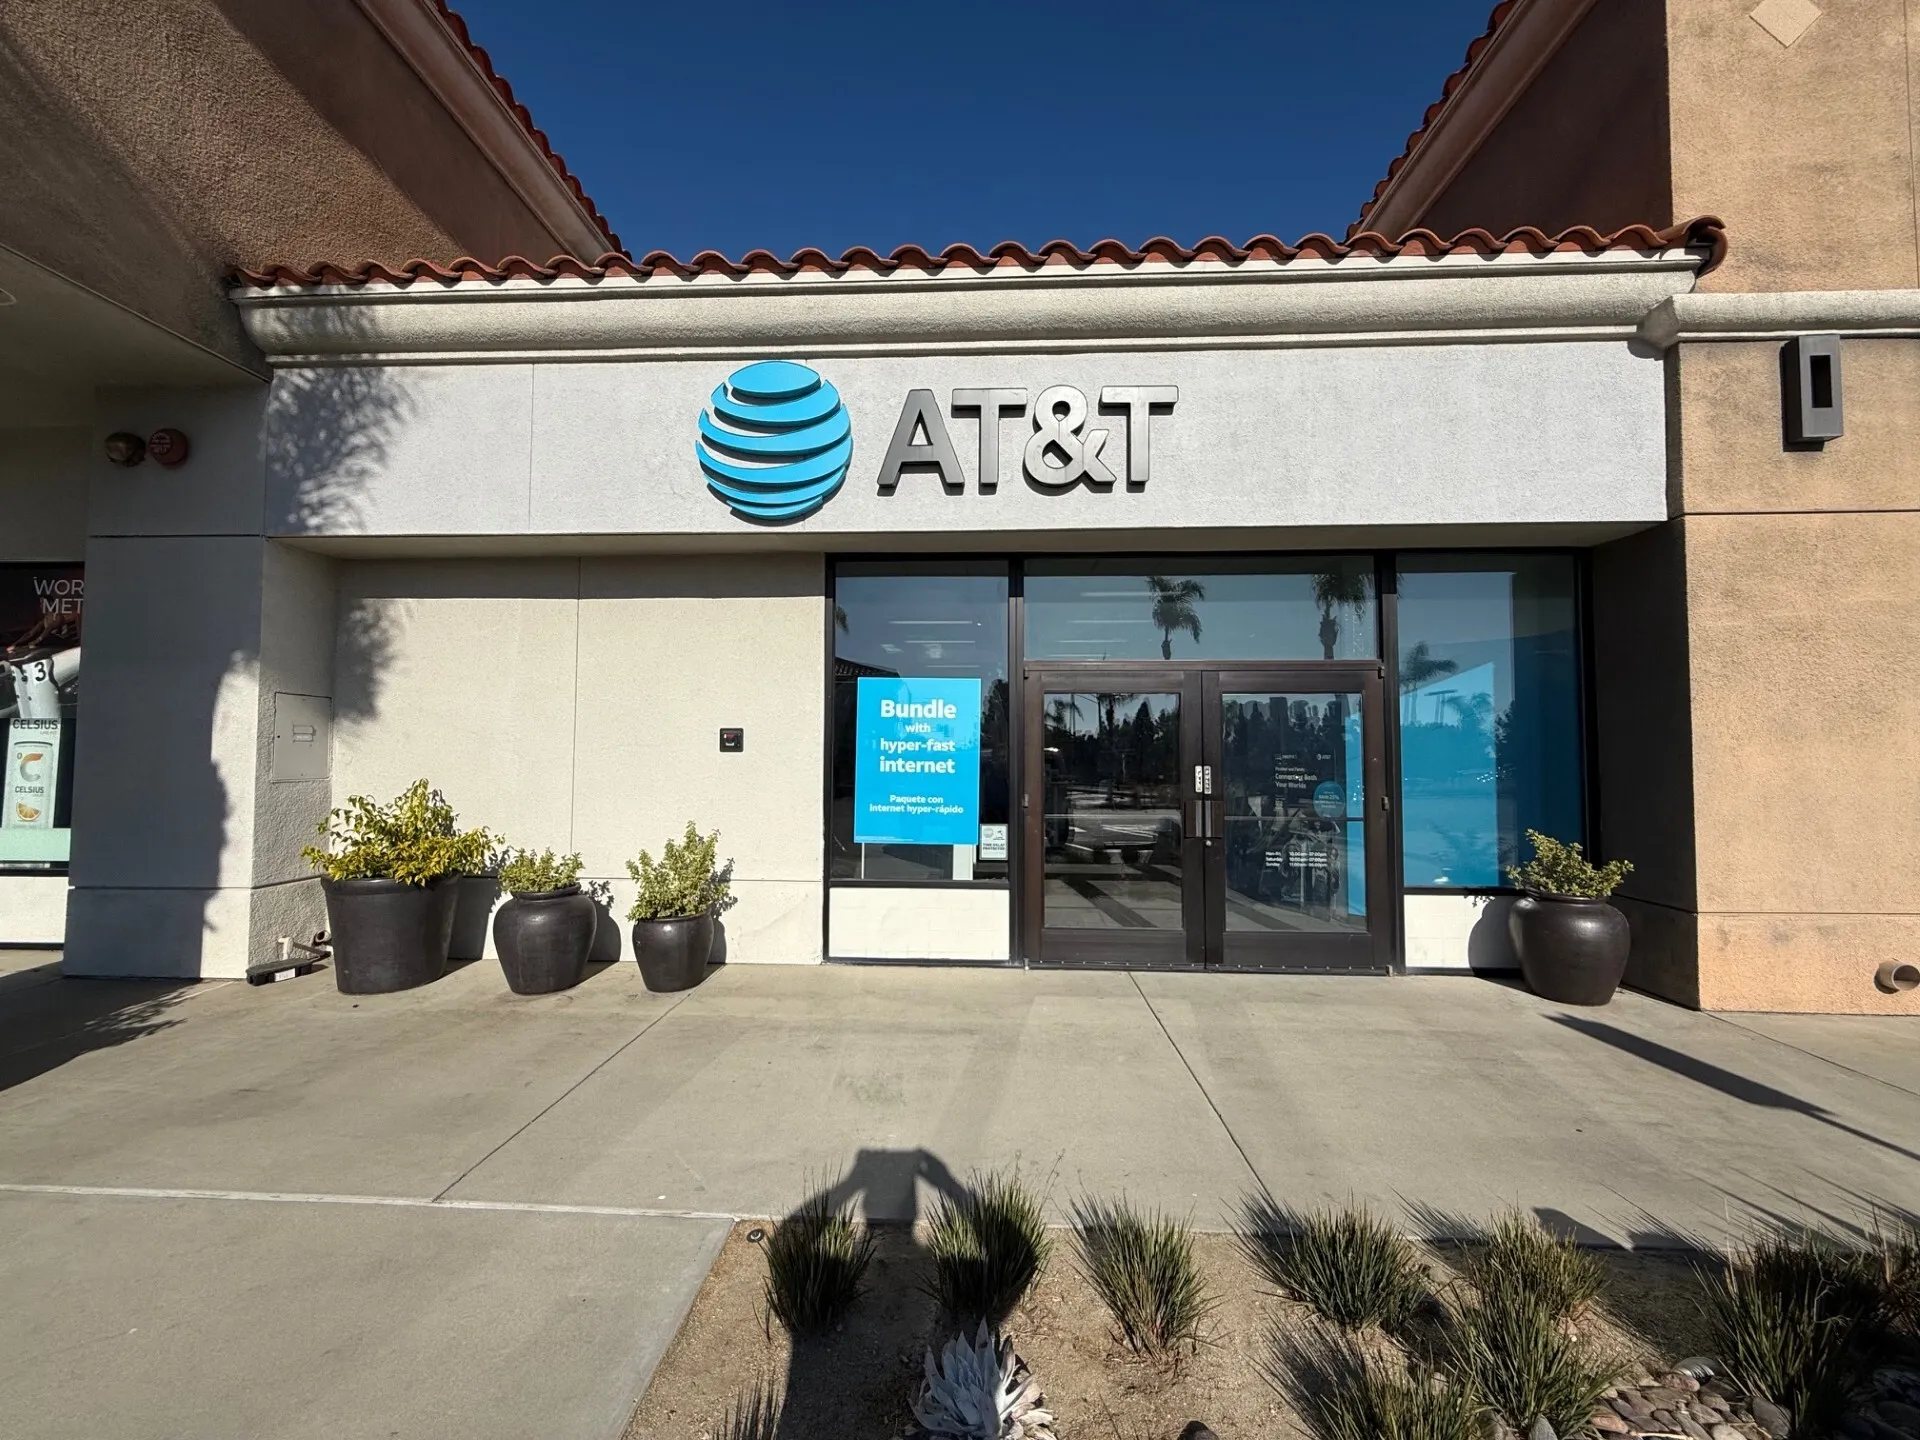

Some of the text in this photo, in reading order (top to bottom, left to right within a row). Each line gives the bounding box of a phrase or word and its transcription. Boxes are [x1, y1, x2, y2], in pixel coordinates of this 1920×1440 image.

[877, 385, 1179, 488] AT&T
[880, 699, 957, 719] Bundle
[13, 718, 58, 730] CELSIUS
[905, 723, 932, 733] with
[880, 738, 956, 754] hyper-fast
[880, 756, 956, 774] internet
[14, 785, 44, 793] CELSIUS
[889, 795, 926, 804] Paquete
[906, 805, 964, 815] hyper-rápido
